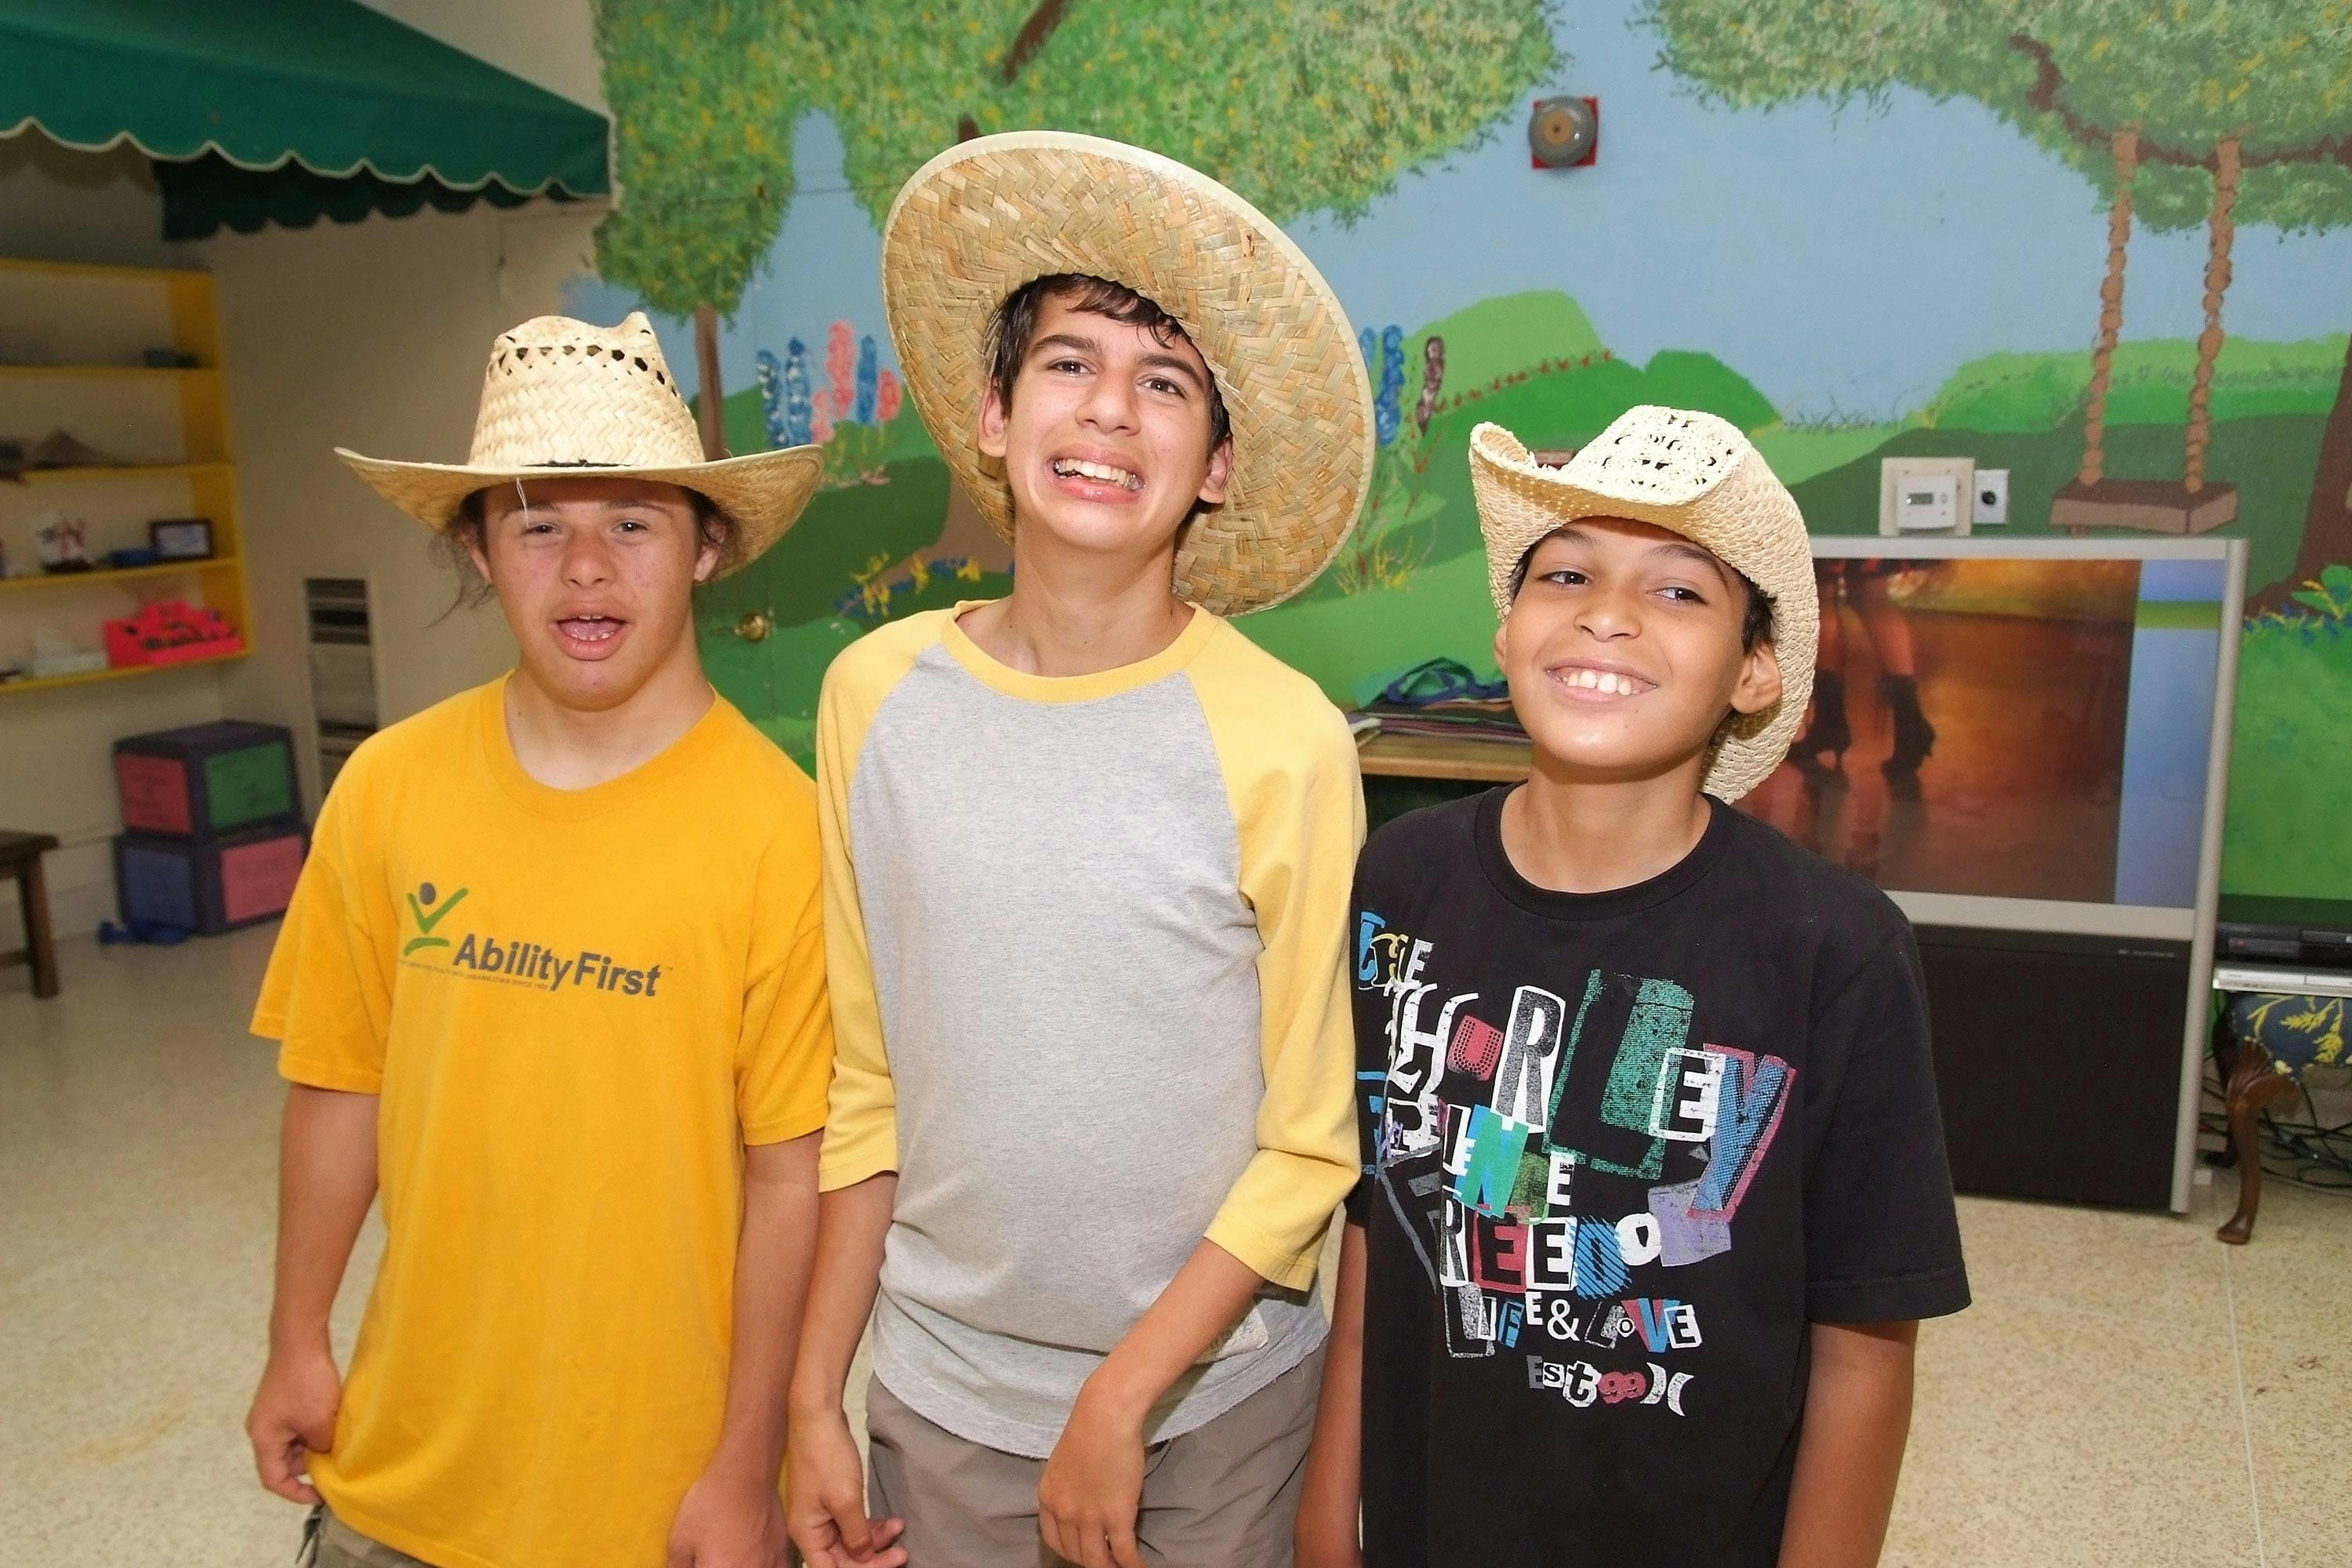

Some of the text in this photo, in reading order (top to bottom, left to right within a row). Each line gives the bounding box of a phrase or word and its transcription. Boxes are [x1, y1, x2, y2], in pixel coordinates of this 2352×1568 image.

[452, 934, 662, 997] AbilityFirst
[1547, 1298, 1580, 1342] &
[1584, 1298, 1703, 1354] LOVE
